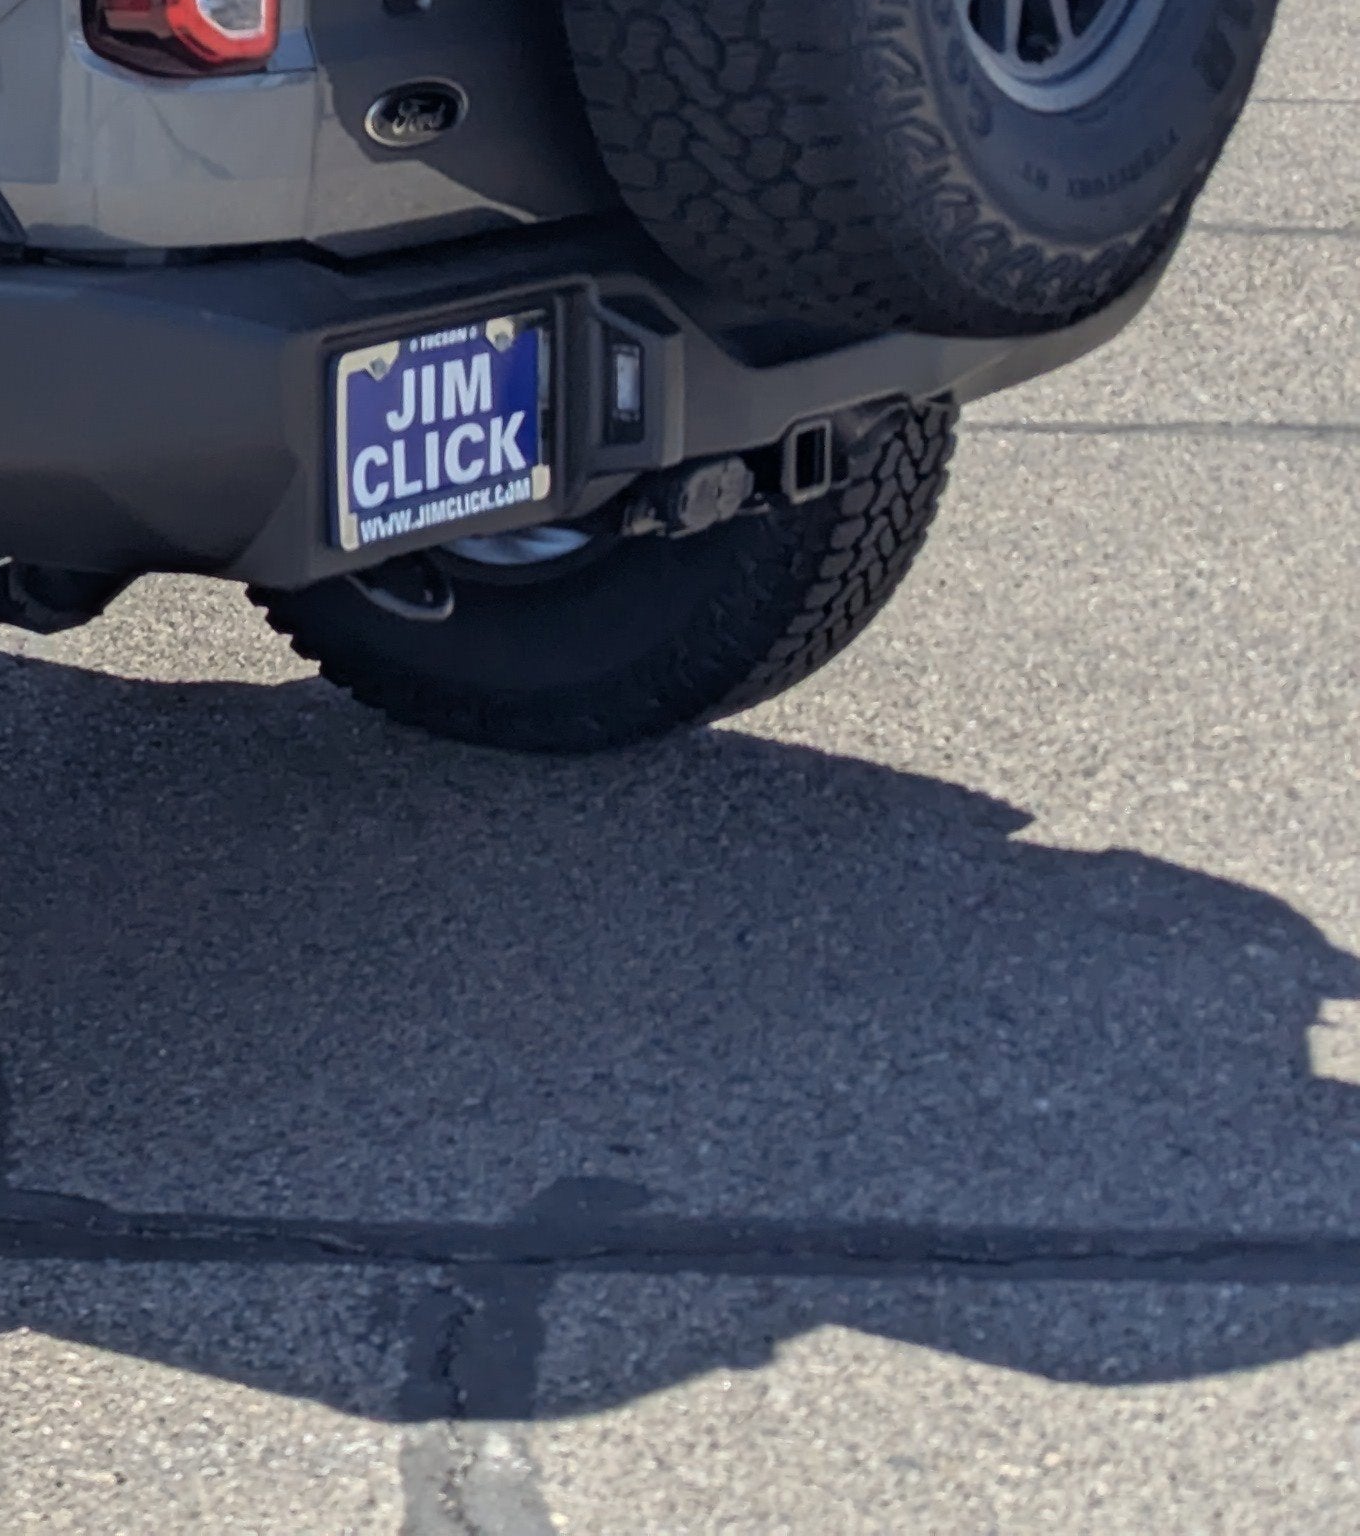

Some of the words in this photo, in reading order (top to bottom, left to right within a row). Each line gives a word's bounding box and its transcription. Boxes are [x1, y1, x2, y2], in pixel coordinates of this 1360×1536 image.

[385, 352, 493, 432] JIM
[352, 410, 527, 509] CLICK
[360, 476, 531, 544] WWW.JIMCLICK.COM
